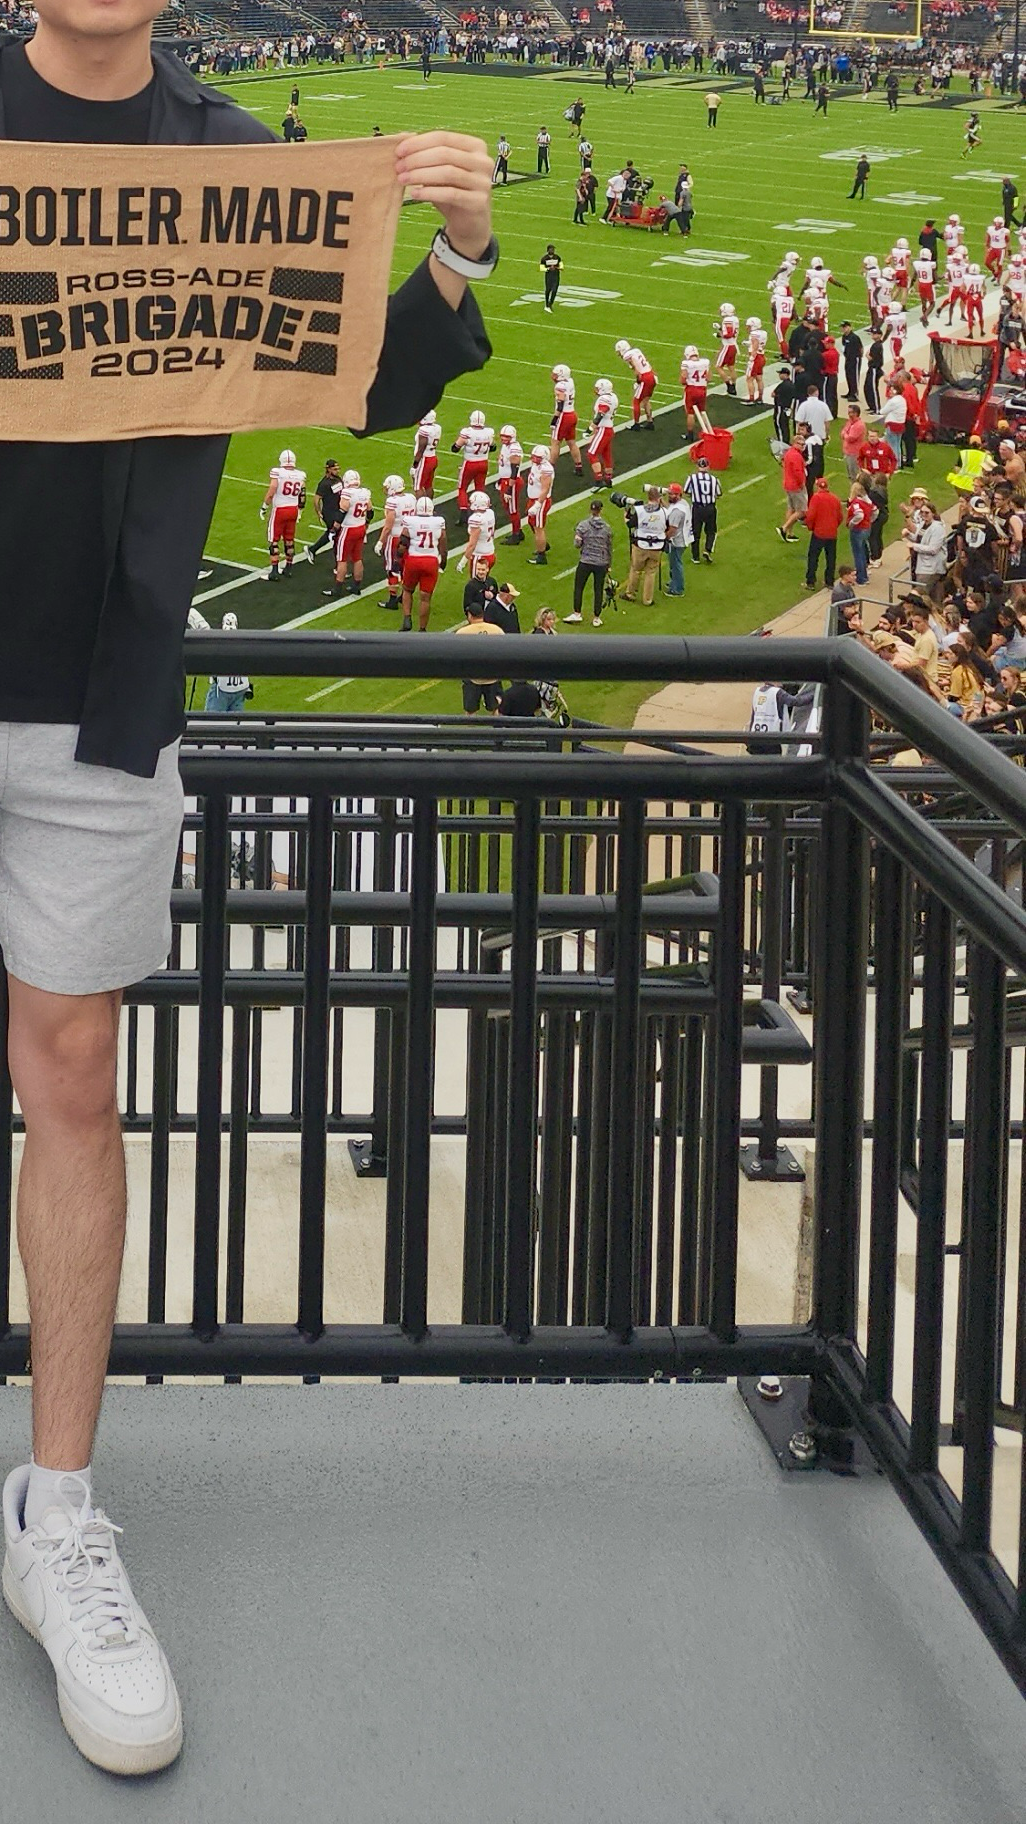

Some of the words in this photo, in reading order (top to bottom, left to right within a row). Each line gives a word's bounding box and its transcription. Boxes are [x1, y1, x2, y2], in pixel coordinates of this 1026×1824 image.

[200, 186, 354, 250] MADE
[66, 267, 267, 295] ROSS-ADE
[21, 293, 305, 360] BRIGADE
[90, 346, 226, 377] 2024
[692, 370, 708, 382] 44
[474, 442, 490, 455] 77
[282, 481, 301, 497] 66
[416, 531, 434, 548] 71
